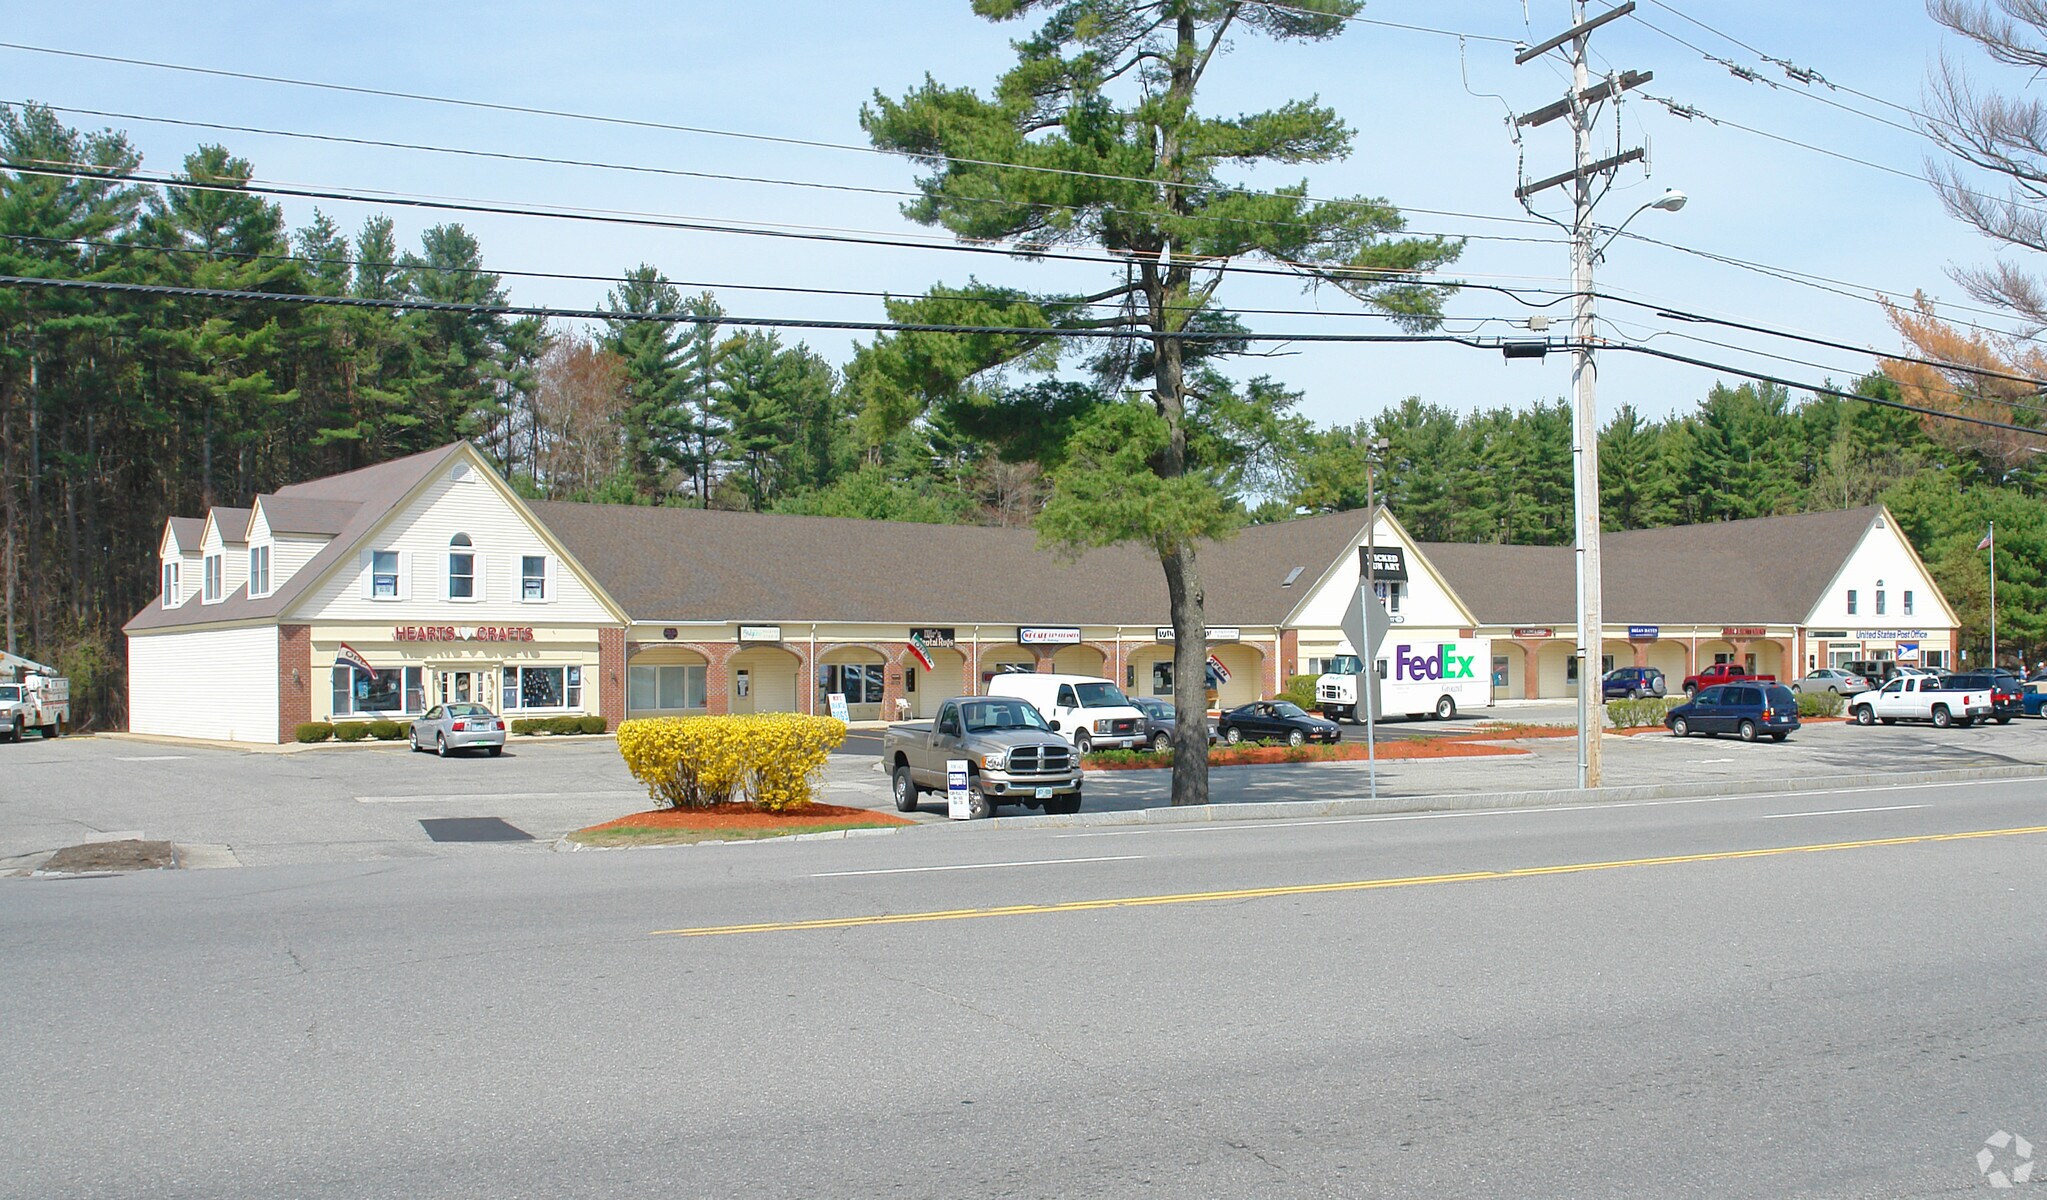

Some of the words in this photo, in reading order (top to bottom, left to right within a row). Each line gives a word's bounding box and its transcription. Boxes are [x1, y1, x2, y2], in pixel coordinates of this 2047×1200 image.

[394, 626, 455, 641] HEARTS
[476, 627, 535, 641] CRAFTS
[1856, 630, 1876, 639] United
[1877, 630, 1896, 639] States
[1897, 630, 1910, 639] Post
[1911, 629, 1928, 639] Office
[345, 650, 367, 666] OPE
[1396, 644, 1474, 681] FedEx
[1210, 658, 1228, 677] OPEN
